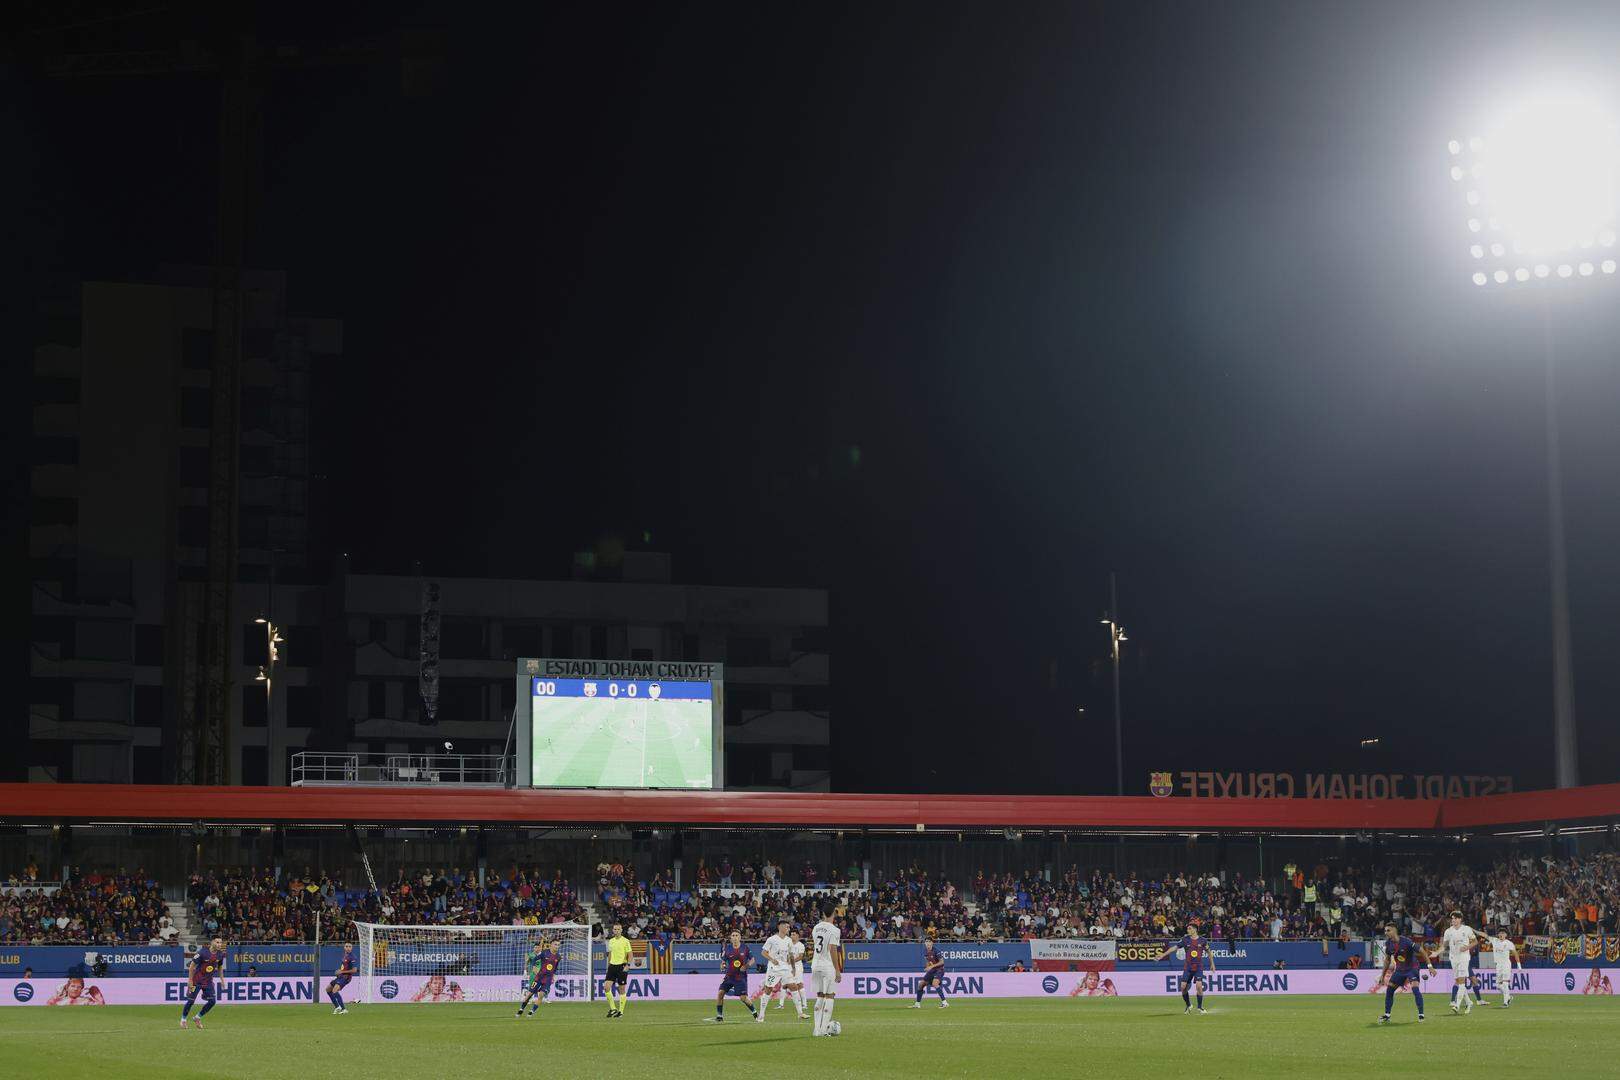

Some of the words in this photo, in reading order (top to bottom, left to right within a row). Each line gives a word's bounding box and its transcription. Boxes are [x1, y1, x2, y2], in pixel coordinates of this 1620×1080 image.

[545, 660, 598, 676] ESTADI
[602, 662, 653, 678] JOHAN
[657, 663, 715, 678] CRUYFF
[536, 681, 556, 696] 00
[815, 935, 824, 953] 3
[102, 954, 113, 964] FC
[114, 954, 172, 964] BARCELONA
[234, 952, 255, 963] MÉS
[256, 953, 276, 964] QUE
[279, 953, 291, 963] UN
[399, 953, 411, 962] FC
[412, 953, 459, 962] BARCELON
[674, 952, 685, 961] FC
[686, 952, 722, 961] BARCEL
[848, 951, 870, 961] CLUB
[950, 950, 999, 960] BARCELONA
[1118, 948, 1163, 960] SOSES
[1202, 949, 1247, 958] BRCELNA
[0, 955, 20, 965] LUB
[854, 977, 882, 995] ED
[1476, 972, 1530, 991] SHEAN
[216, 981, 313, 1001] HEERAN
